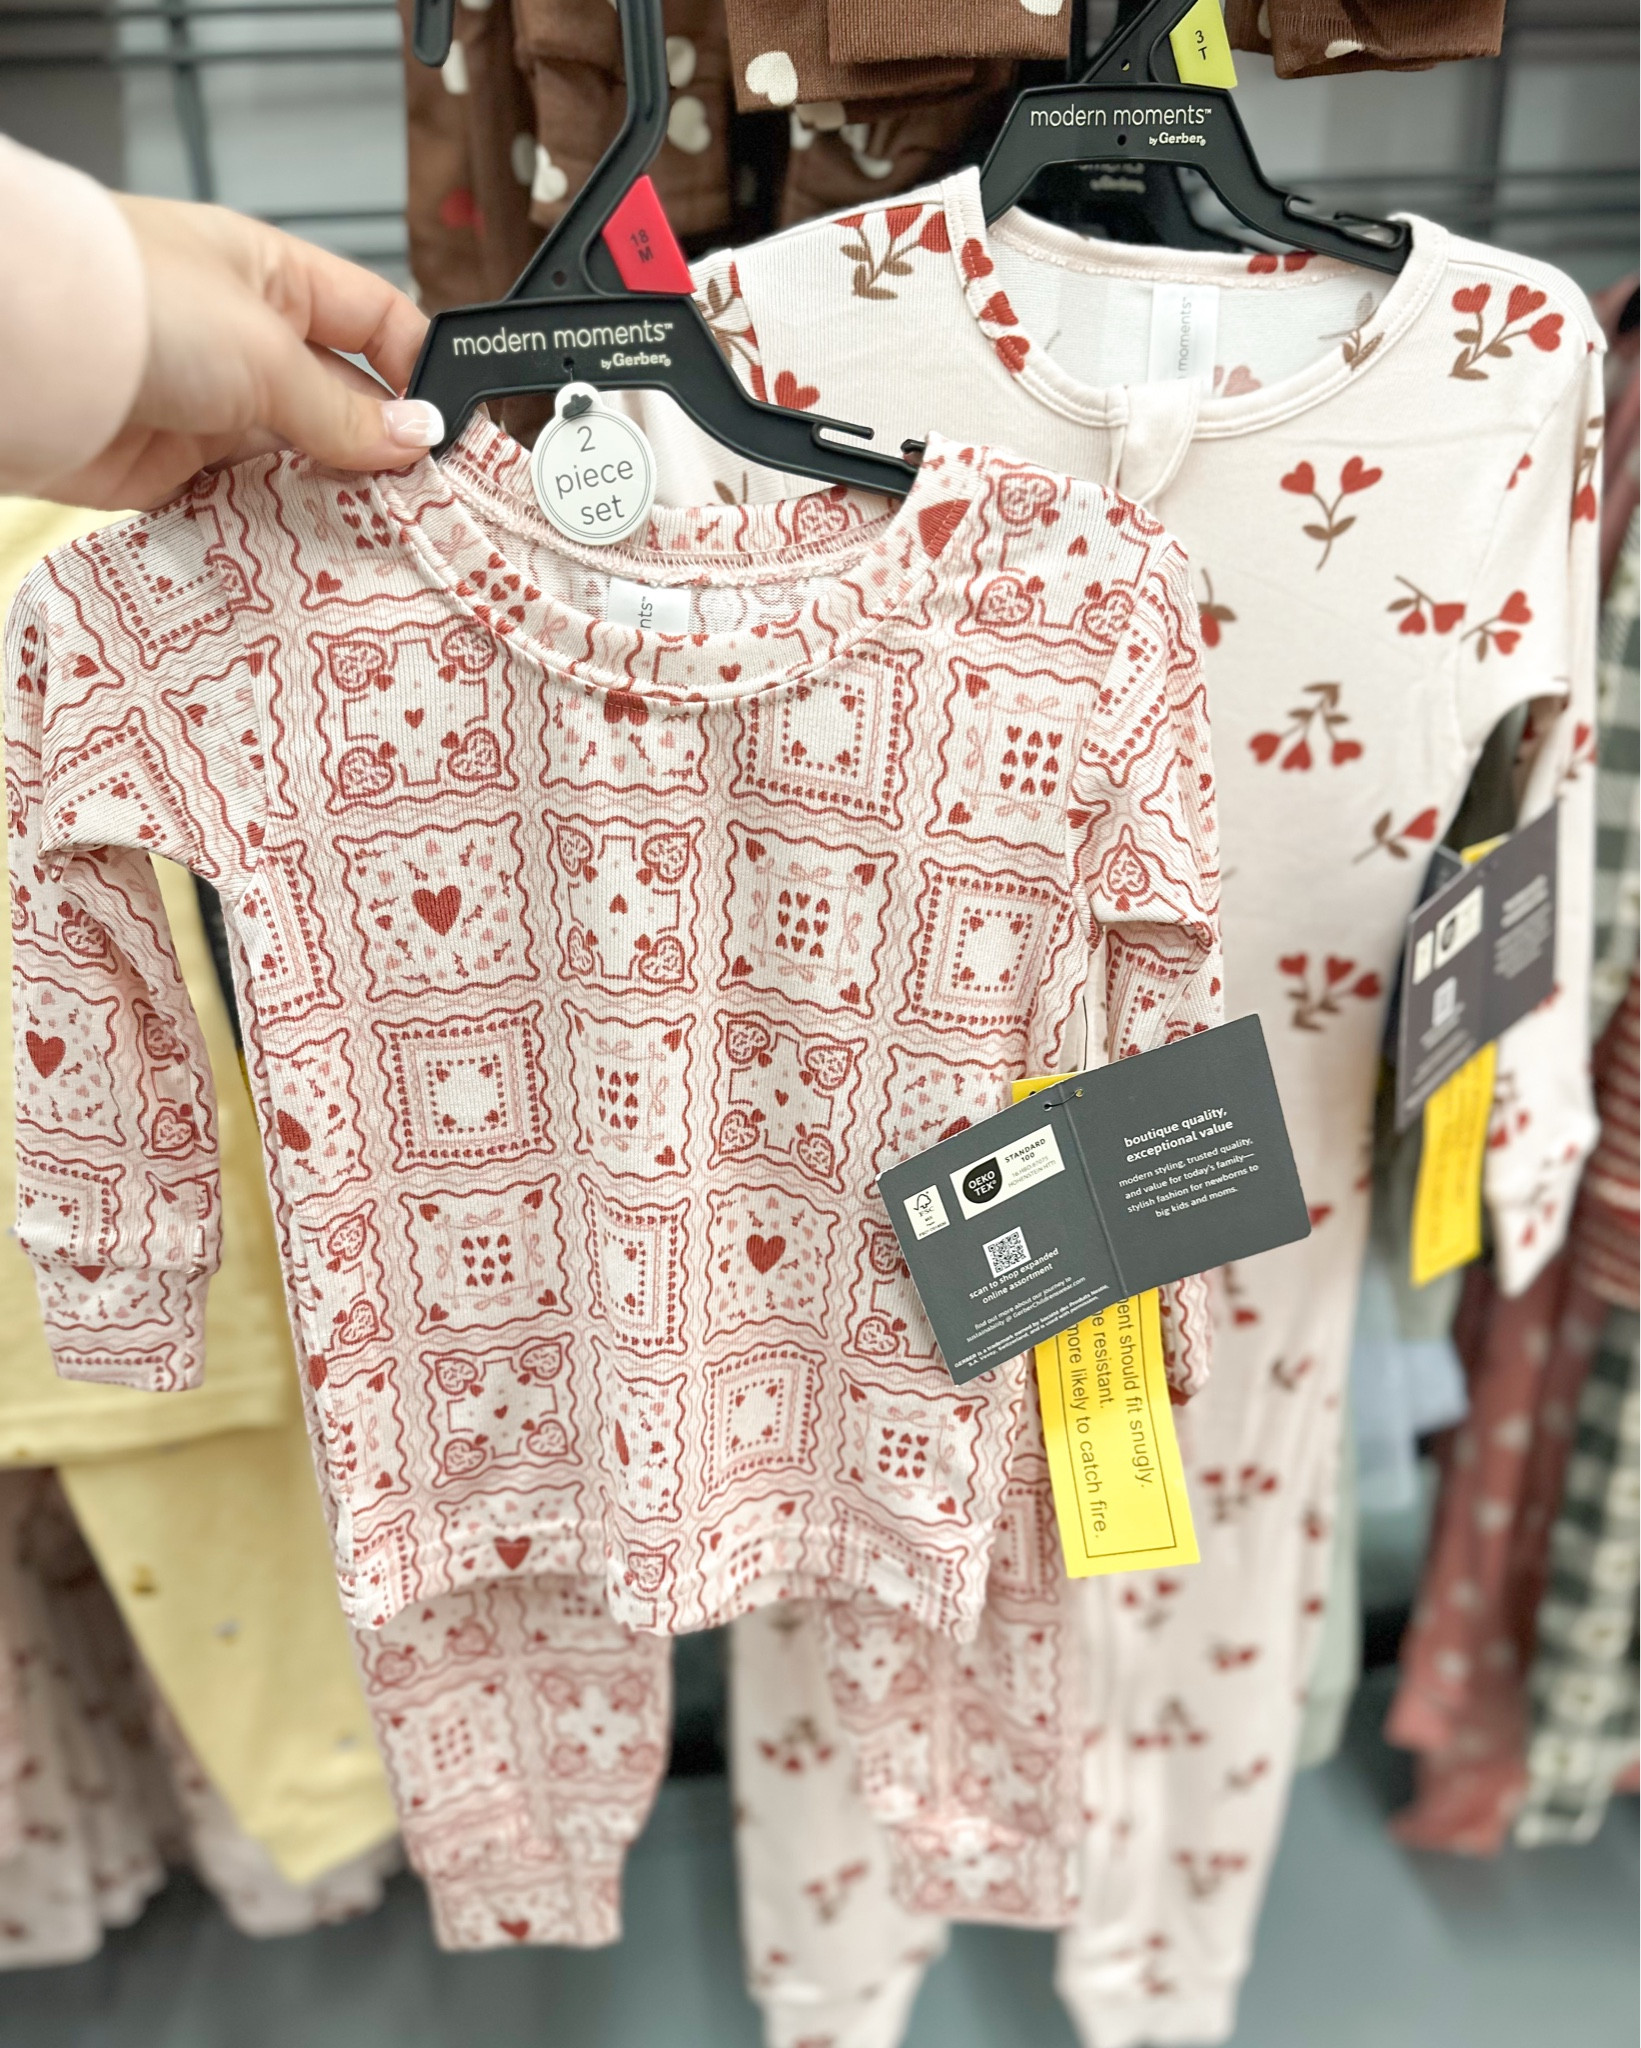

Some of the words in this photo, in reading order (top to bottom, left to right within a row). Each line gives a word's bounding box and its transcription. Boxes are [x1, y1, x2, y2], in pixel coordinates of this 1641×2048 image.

[1195, 30, 1204, 43] 3
[1198, 46, 1207, 60] T
[1030, 104, 1107, 127] modern
[1149, 136, 1158, 146] by
[630, 229, 649, 247] 18
[638, 246, 654, 263] M
[453, 327, 547, 356] modern
[601, 359, 612, 369] by
[577, 425, 596, 452] 2
[555, 460, 634, 500] piece
[581, 495, 625, 525] set
[1124, 1123, 1179, 1148] boutique
[1181, 1108, 1228, 1129] quality,
[1126, 1131, 1198, 1162] exceptional
[1199, 1121, 1234, 1138] value
[1004, 1138, 1046, 1163] STANDARD
[1021, 1152, 1036, 1162] 100
[968, 1170, 996, 1189] OEKO
[1118, 1170, 1153, 1188] modern
[1186, 1148, 1219, 1164] trusted
[1124, 1188, 1142, 1200] and
[1142, 1180, 1168, 1194] value
[1168, 1175, 1182, 1185] for
[1127, 1198, 1156, 1213] stylish
[1156, 1188, 1189, 1204] fashion
[1190, 1183, 1203, 1193] for
[1204, 1169, 1248, 1188] newborns
[1249, 1164, 1260, 1173] to
[1155, 1208, 1171, 1218] big
[1171, 1201, 1190, 1212] kids
[1190, 1195, 1208, 1206] and
[969, 1286, 989, 1299] scan
[989, 1280, 999, 1288] to
[999, 1269, 1019, 1284] shop
[1019, 1248, 1059, 1273] expanded
[982, 1287, 1008, 1304] online
[1008, 1263, 1054, 1291] assortment
[1093, 1332, 1115, 1410] resistant.
[1119, 1335, 1140, 1391] should
[1070, 1368, 1088, 1413] likely
[1125, 1395, 1144, 1414] fit
[1075, 1415, 1091, 1434] to
[1079, 1440, 1102, 1494] catch
[1129, 1420, 1154, 1489] snugly.
[1089, 1499, 1108, 1540] fire.
